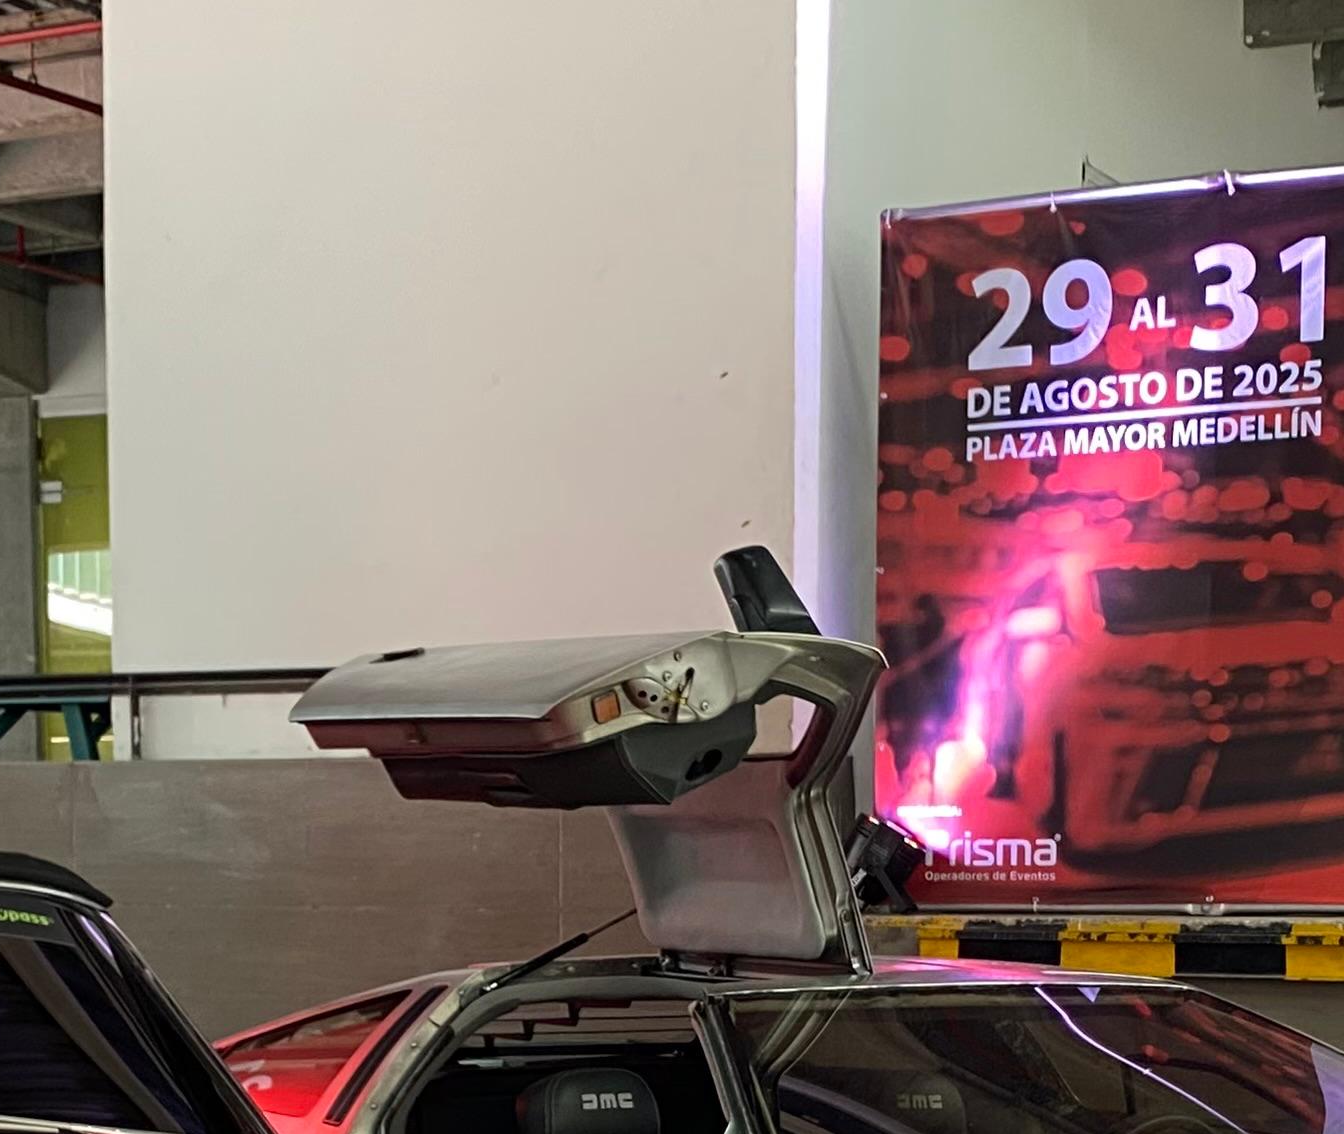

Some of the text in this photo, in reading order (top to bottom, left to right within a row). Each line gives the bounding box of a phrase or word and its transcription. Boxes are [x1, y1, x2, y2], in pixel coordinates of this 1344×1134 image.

[968, 235, 1327, 371] 29 AL 31
[967, 359, 1322, 419] DE AGOSTO DE 2025
[965, 407, 1322, 462] PLAZA MAYOR MEDELLÍN
[925, 871, 1056, 881] Operadores de Eventos
